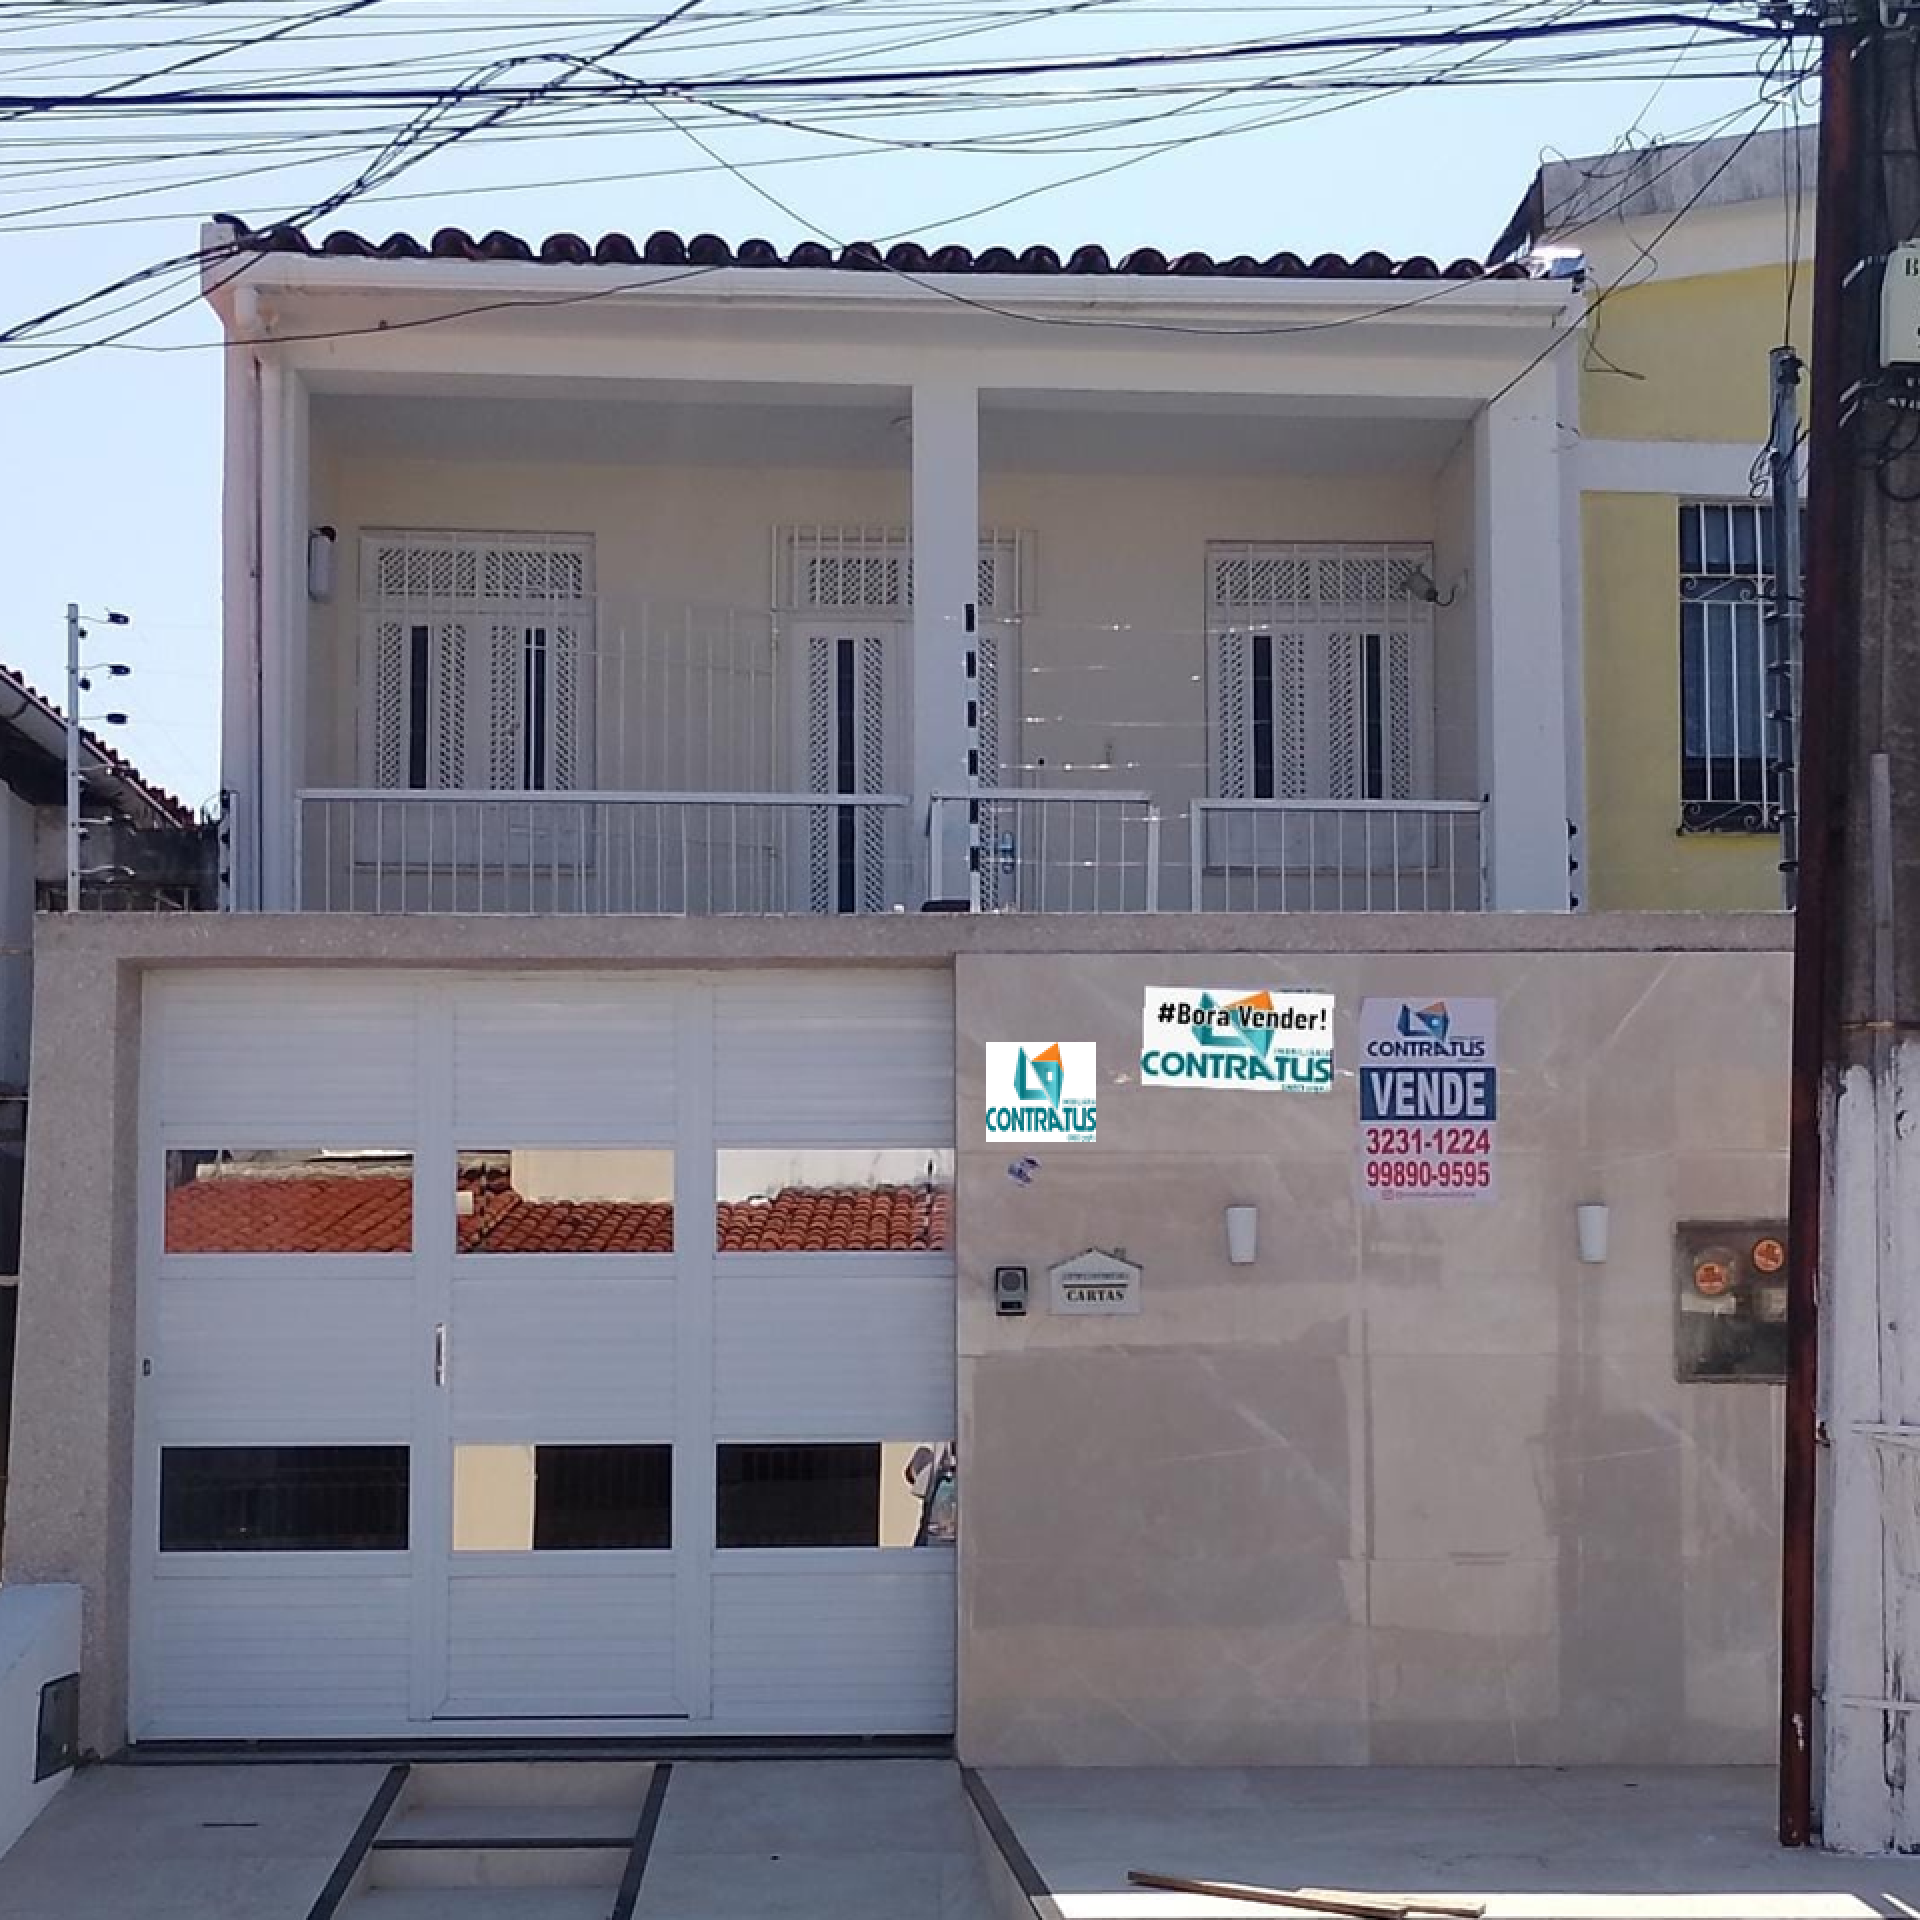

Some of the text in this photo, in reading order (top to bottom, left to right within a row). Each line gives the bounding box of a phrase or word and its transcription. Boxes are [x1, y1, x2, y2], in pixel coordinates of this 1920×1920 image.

[1367, 1041, 1485, 1057] CONTRATUS
[1370, 1071, 1486, 1117] VENDE
[1367, 1128, 1490, 1155] 3231-1224
[1367, 1161, 1490, 1187] 99890-9595
[1067, 1289, 1125, 1302] CARTAS
